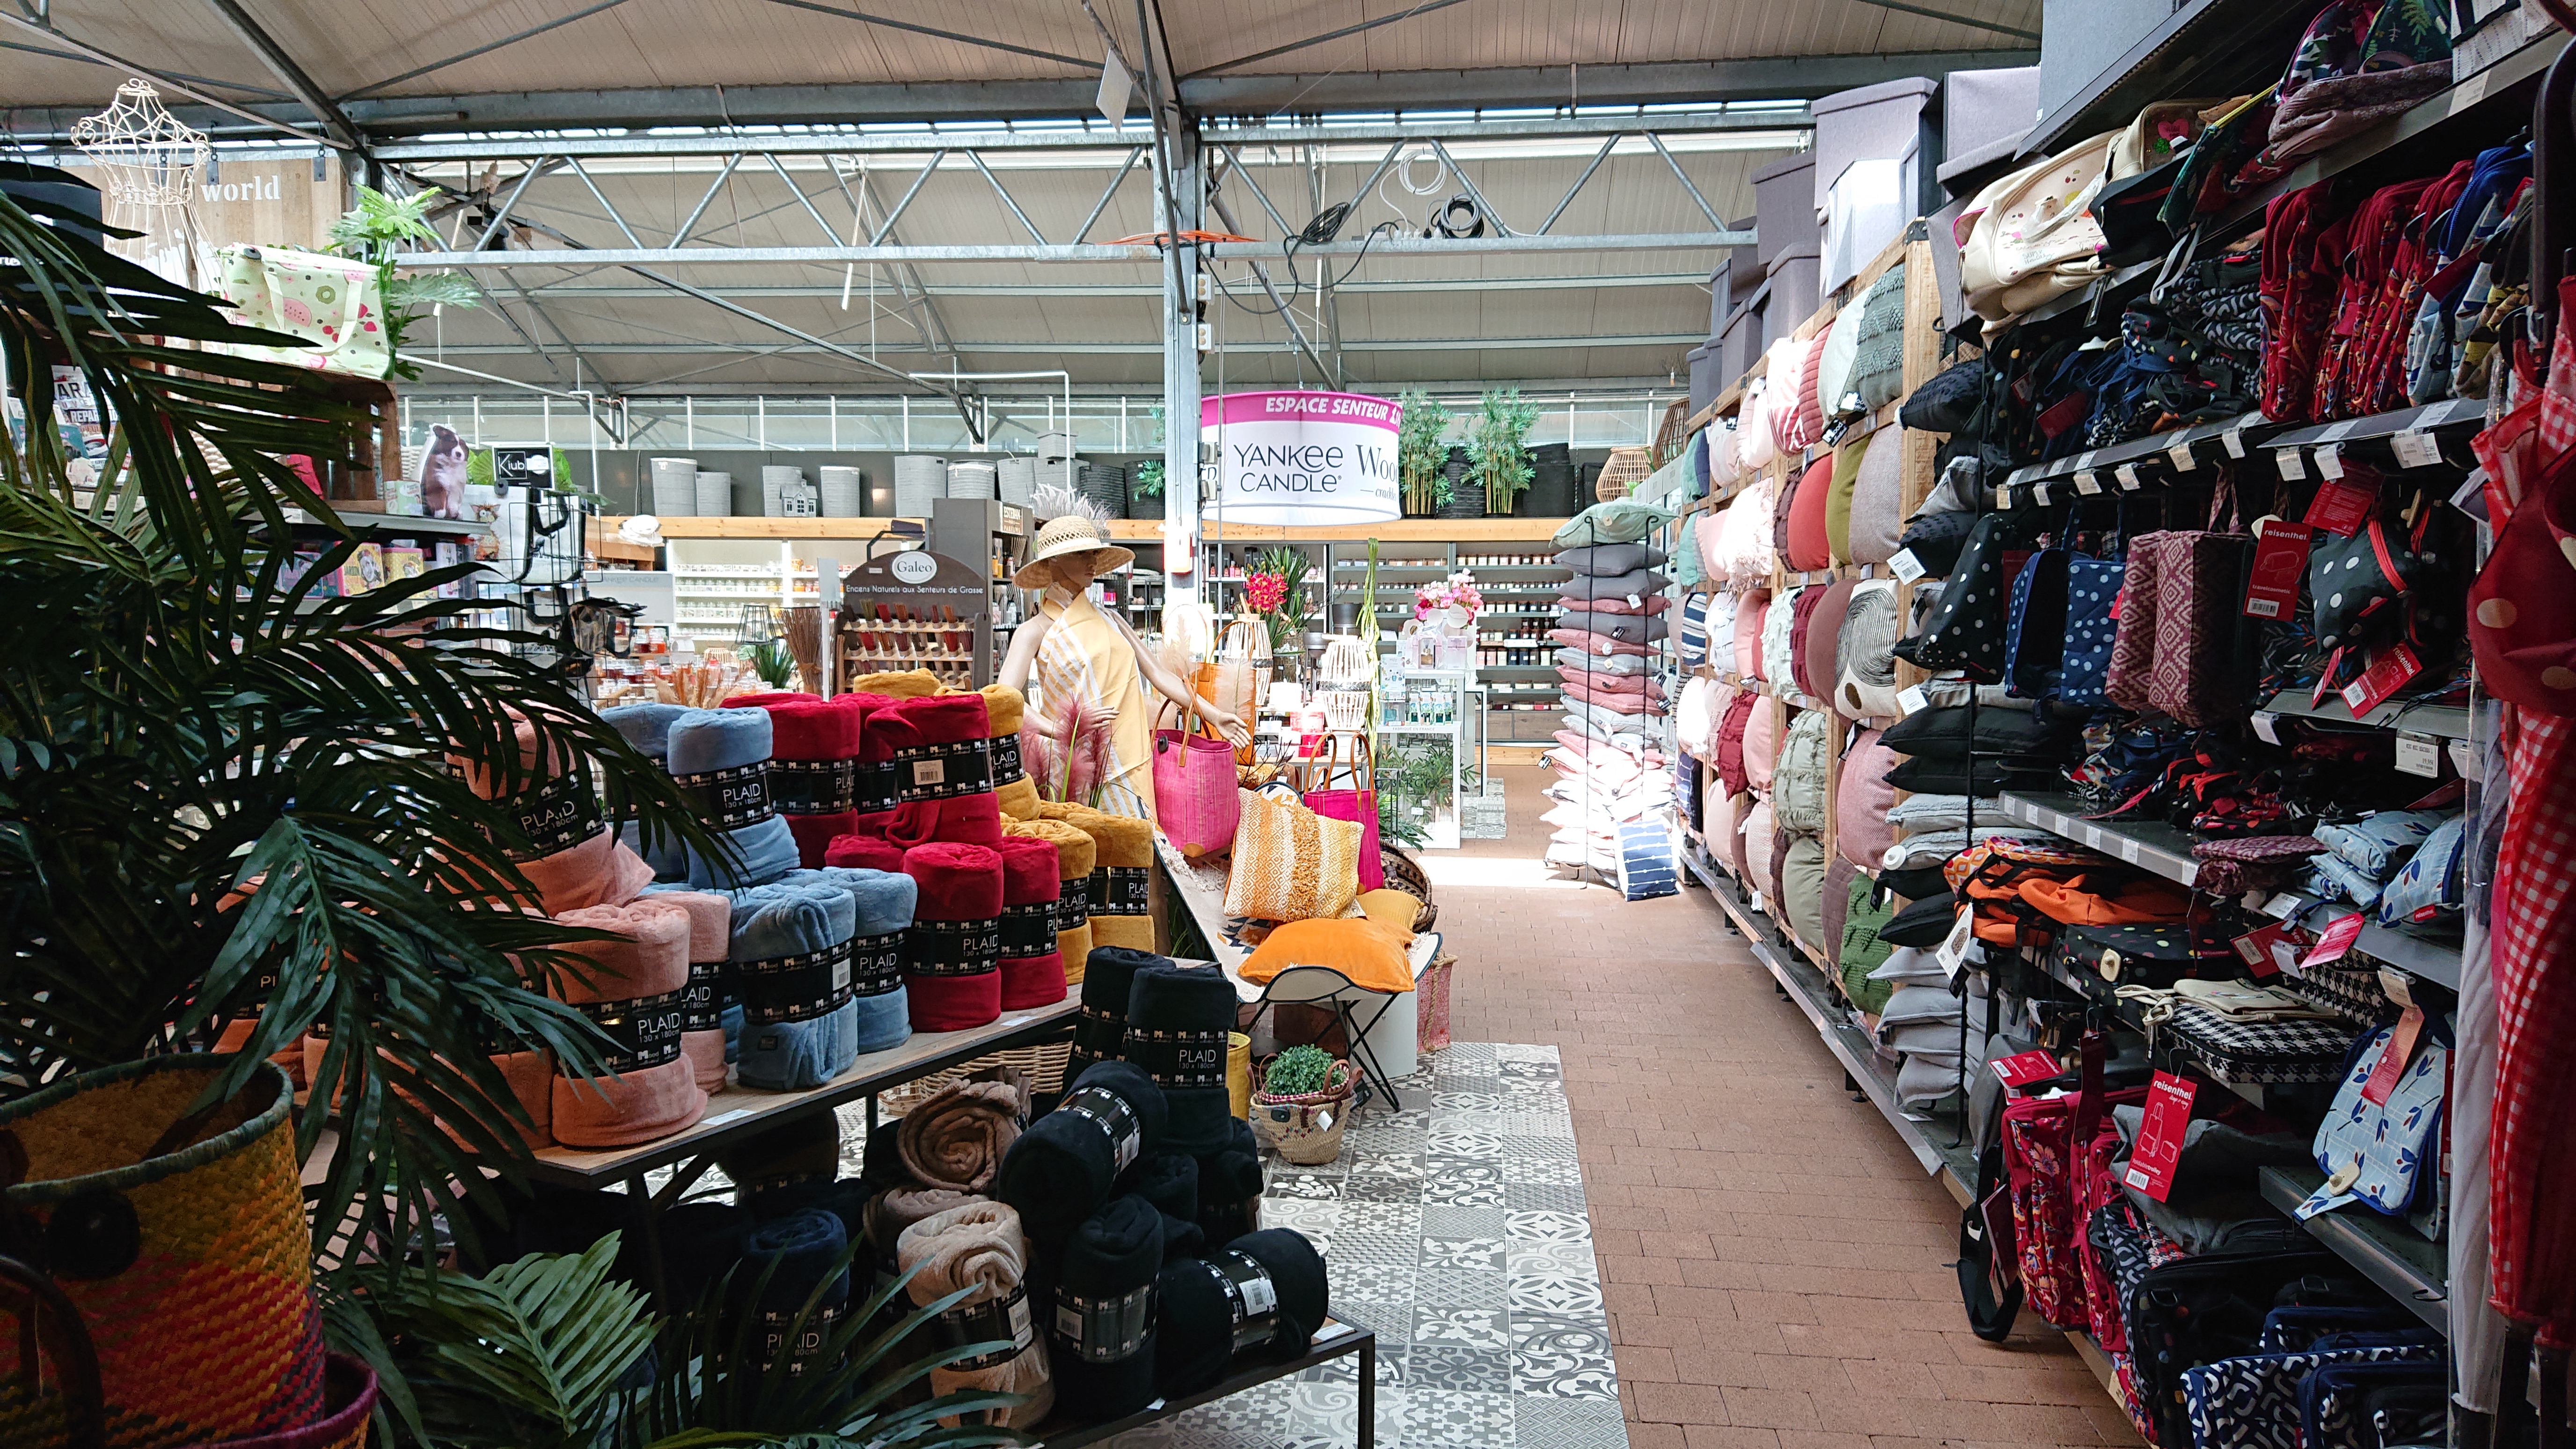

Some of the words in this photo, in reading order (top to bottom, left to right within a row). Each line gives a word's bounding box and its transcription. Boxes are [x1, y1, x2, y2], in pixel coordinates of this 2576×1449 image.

[201, 175, 280, 202] world
[1266, 398, 1329, 413] ESPACE
[1332, 399, 1389, 421] SENTEUR
[498, 454, 525, 477] Kiub
[1003, 506, 1020, 520] ESTEBAN
[1004, 525, 1020, 534] PARFUMS
[2264, 529, 2307, 541] reisenthel
[897, 561, 932, 573] Galeo
[872, 585, 900, 593] Naturels
[2393, 647, 2415, 676] reisenthel
[991, 750, 1017, 766] LAID
[723, 783, 761, 803] PLAID
[1128, 882, 1149, 894] PLAID
[1058, 893, 1086, 907] PLAID
[963, 934, 998, 951] PLAID
[860, 953, 897, 970] PLAID
[680, 986, 711, 1002] LAID
[637, 1012, 681, 1036] PLAID
[639, 1035, 652, 1044] 130
[661, 1029, 680, 1039] 180cm
[1179, 1049, 1216, 1063] PLAID
[2153, 1079, 2193, 1100] reisenthel
[2132, 1158, 2161, 1176] foldabletrolley
